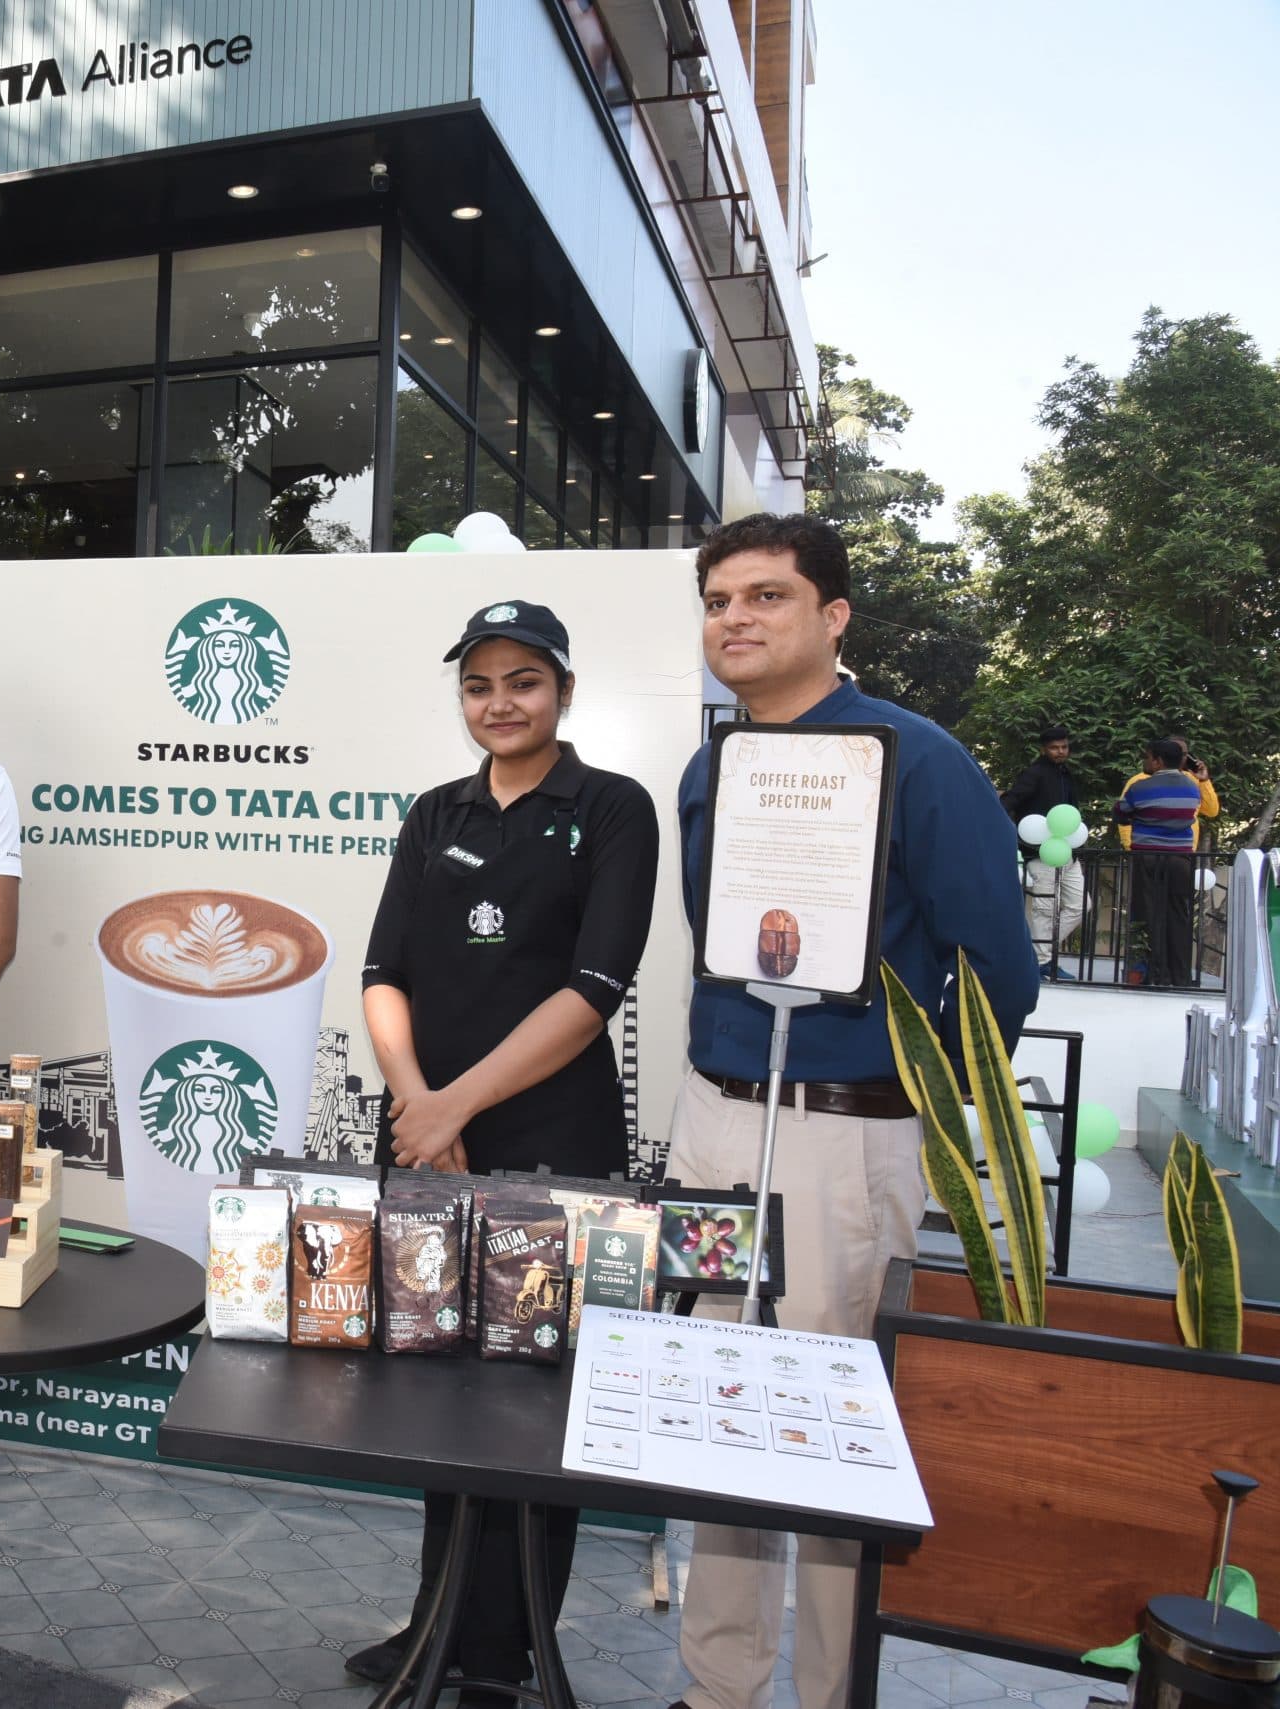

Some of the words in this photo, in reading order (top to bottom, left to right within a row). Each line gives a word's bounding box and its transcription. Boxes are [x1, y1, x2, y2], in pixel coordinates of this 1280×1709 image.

[81, 34, 252, 92] Alliance
[137, 742, 309, 765] STARBUCKS
[750, 772, 797, 788] COFFEE
[801, 774, 847, 790] ROAST
[31, 783, 160, 816] COMES
[168, 787, 217, 817] TO
[226, 788, 320, 820] TATA
[328, 790, 417, 821] CITY
[759, 793, 832, 810] SPECTRUM
[49, 826, 209, 850] JAMSHEDPUR
[215, 831, 282, 853] WITH
[288, 834, 333, 855] THE
[388, 1212, 455, 1223] SUMATRA
[487, 1228, 528, 1255] ITALIAN
[511, 1235, 552, 1256] ROAST
[592, 1274, 634, 1286] COLOMBIA
[310, 1283, 369, 1311] KENYA
[608, 1312, 645, 1322] SEED
[650, 1317, 671, 1325] TO
[676, 1320, 708, 1329] CUP
[713, 1325, 764, 1336] STORY
[795, 1336, 856, 1349] COFFEE
[36, 1378, 173, 1414] Narayana
[36, 1411, 108, 1438] (near
[115, 1423, 152, 1444] GT
